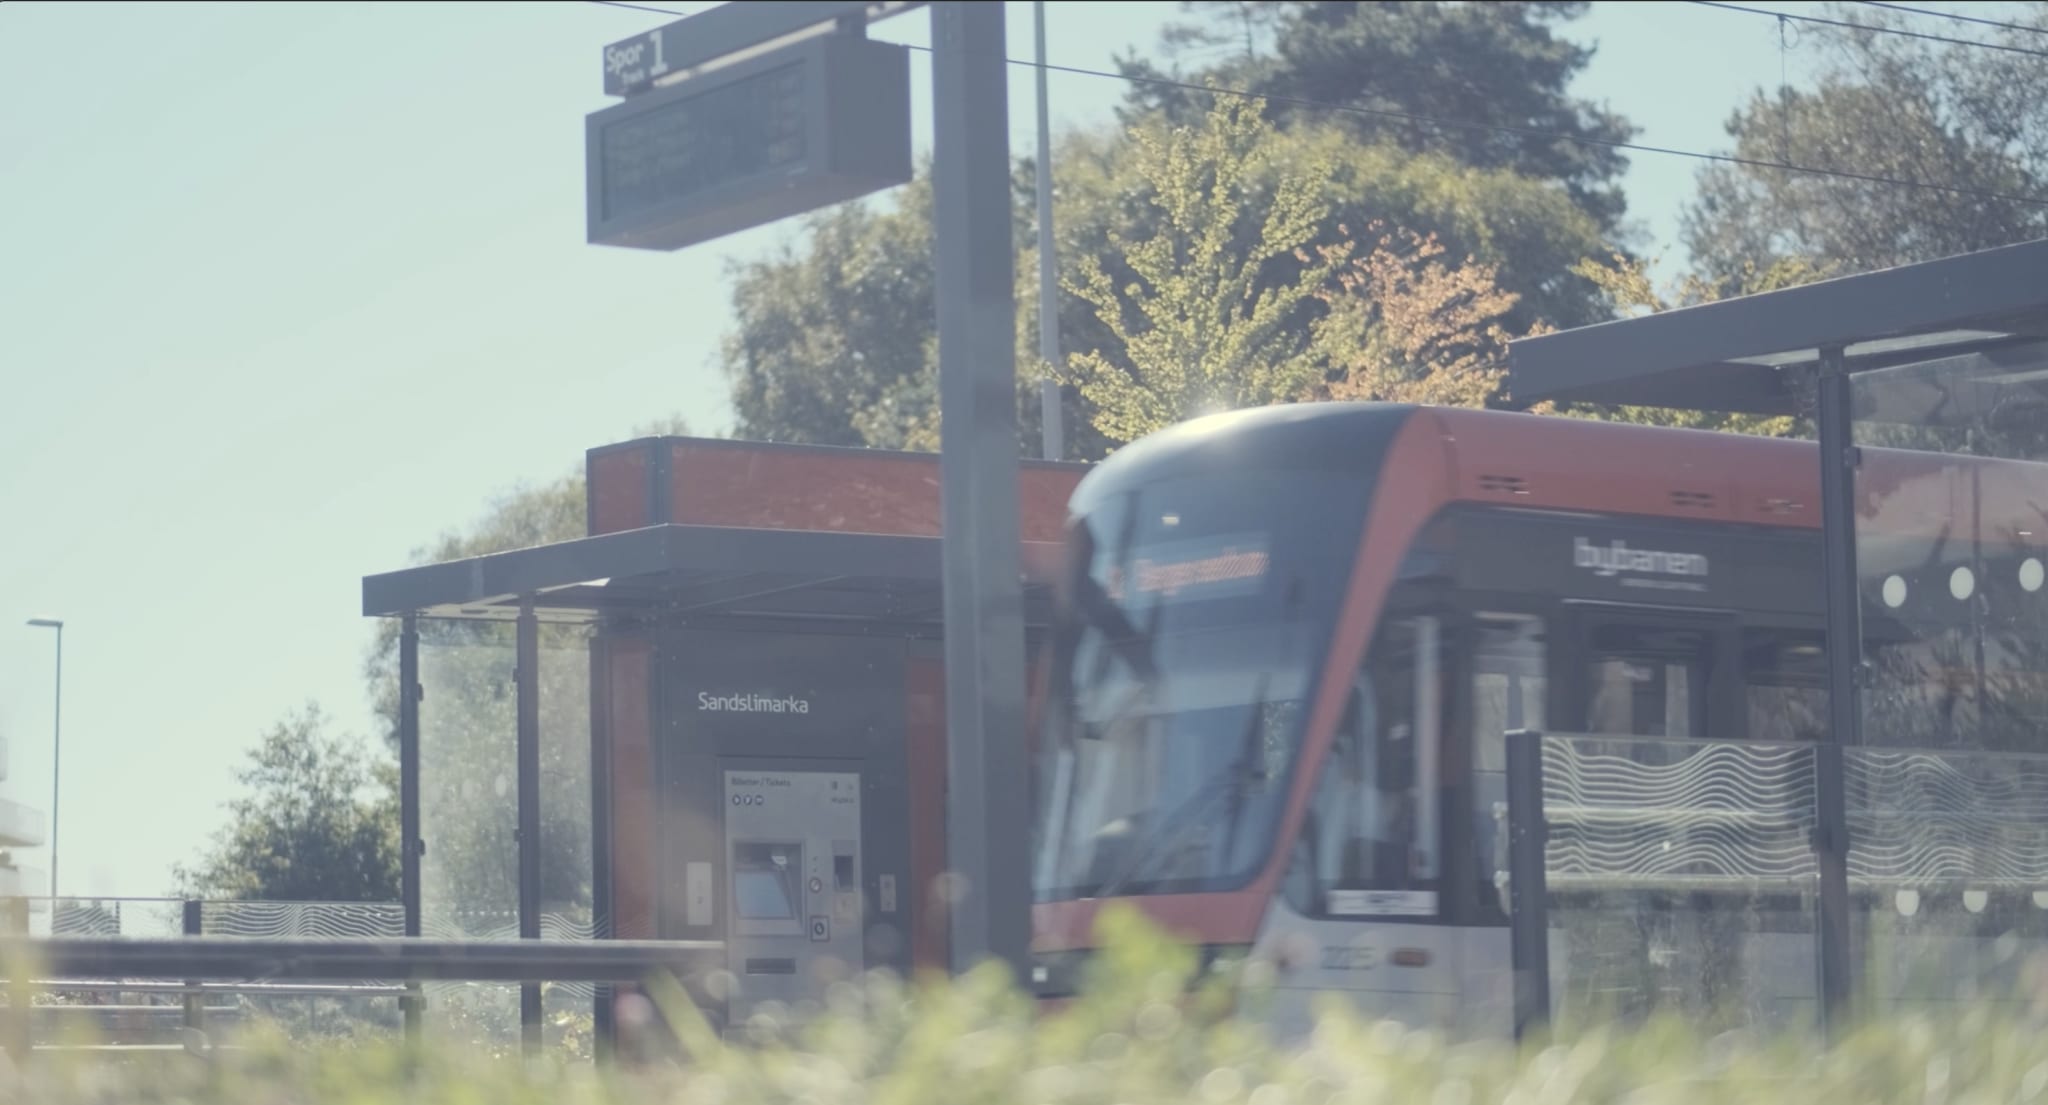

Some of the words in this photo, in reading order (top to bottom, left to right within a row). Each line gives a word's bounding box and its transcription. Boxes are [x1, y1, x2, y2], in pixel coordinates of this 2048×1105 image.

[606, 43, 645, 75] Spor
[649, 30, 668, 76] 1
[698, 691, 809, 714] Sandslimarka
